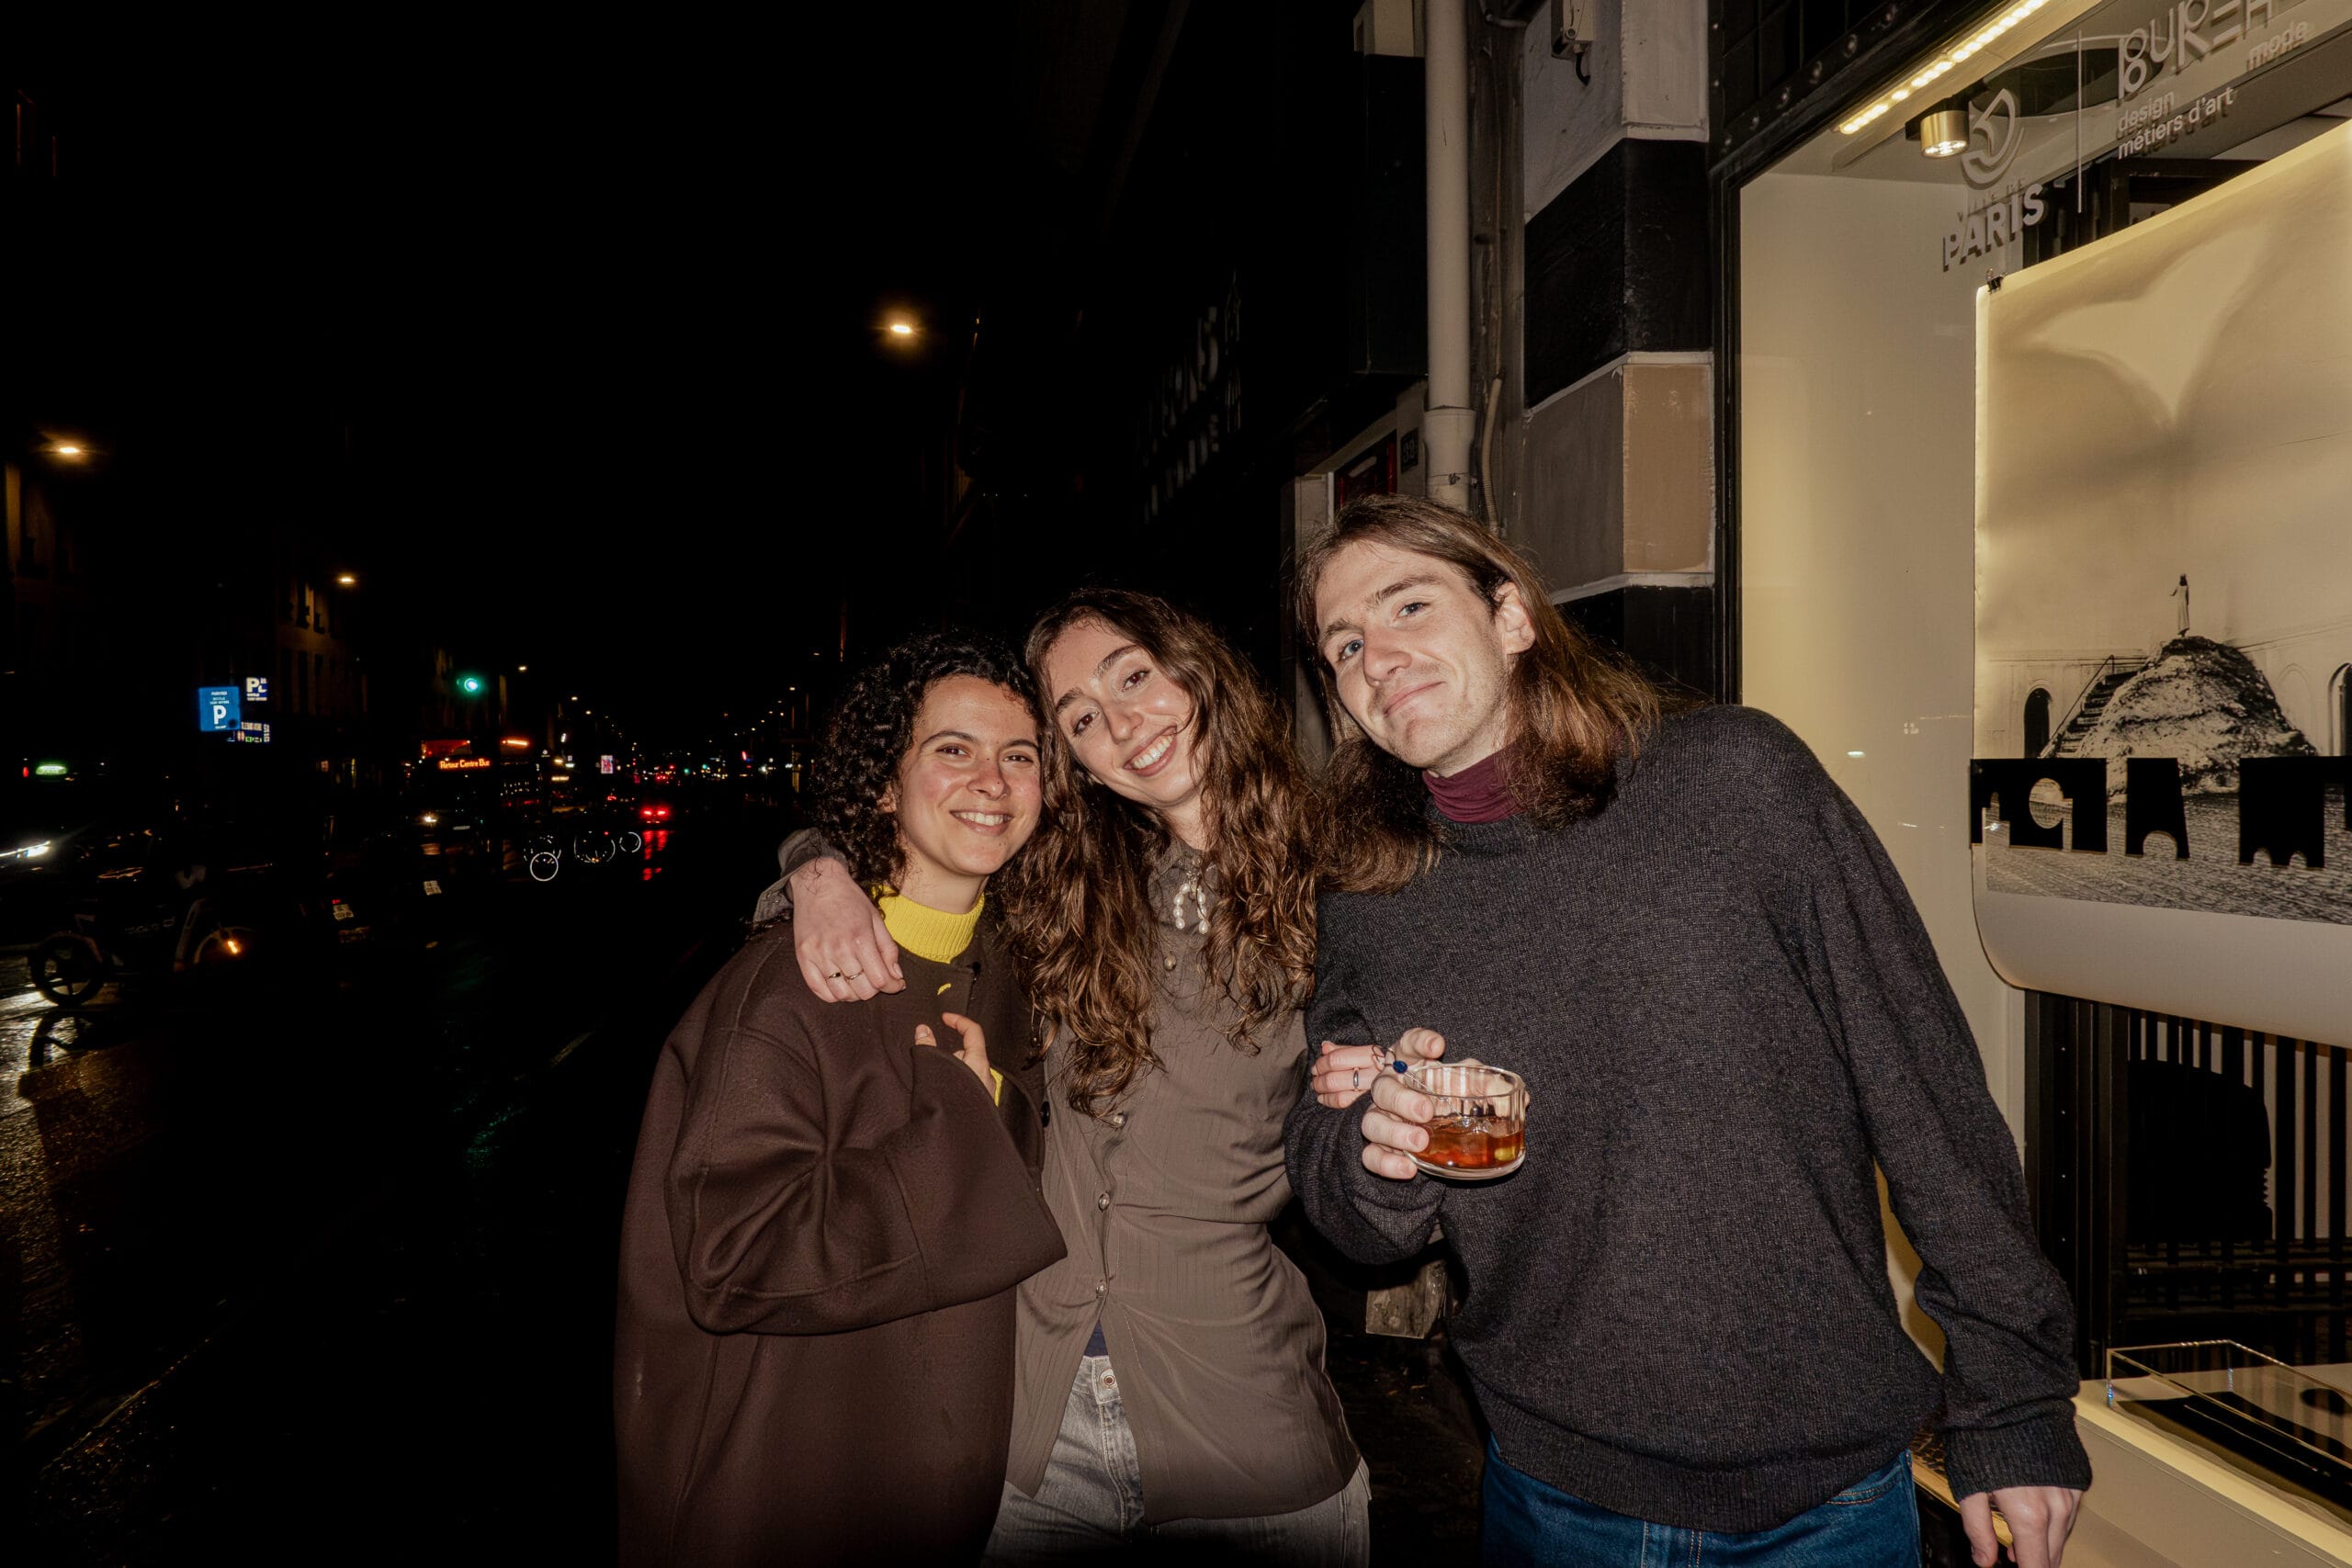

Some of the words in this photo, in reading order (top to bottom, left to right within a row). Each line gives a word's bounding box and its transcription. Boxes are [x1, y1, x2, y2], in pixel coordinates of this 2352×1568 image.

[2249, 21, 2308, 65] mode
[2118, 114, 2184, 160] métiers
[2188, 86, 2234, 124] d'art
[2119, 91, 2175, 132] design
[1944, 183, 2044, 266] PARIS
[213, 705, 227, 725] P
